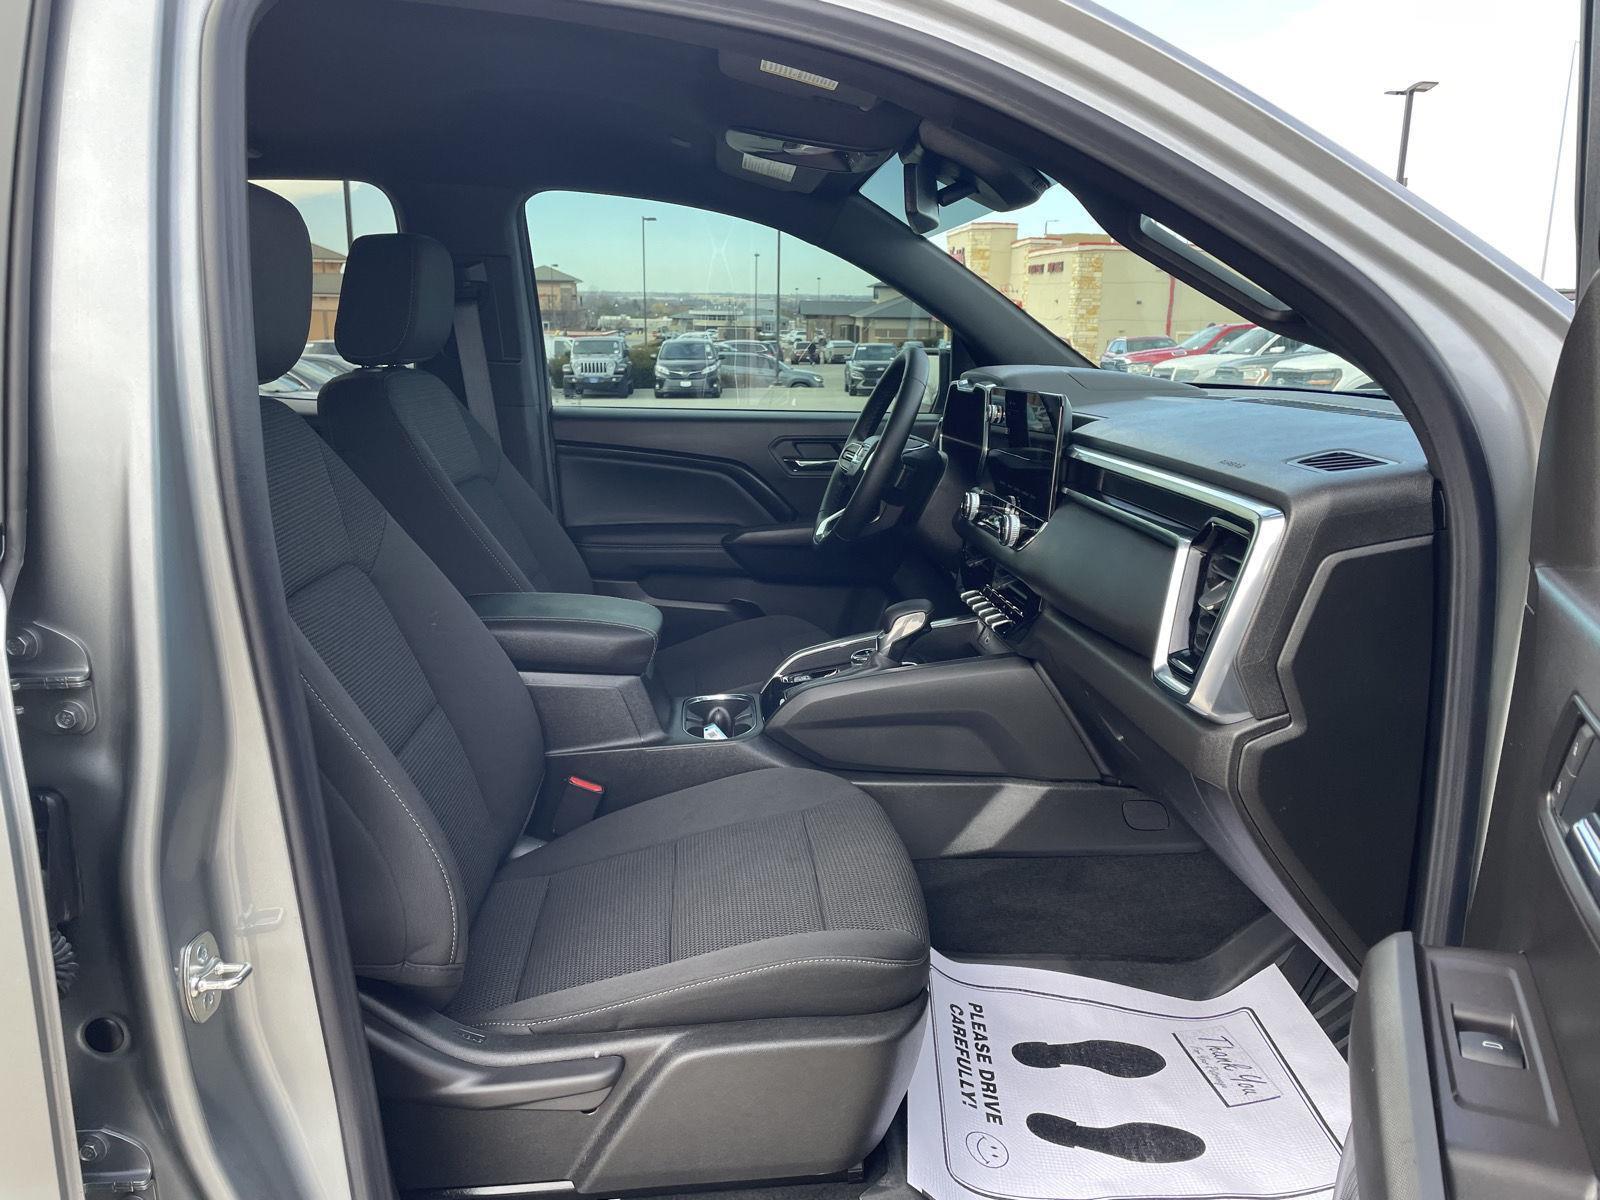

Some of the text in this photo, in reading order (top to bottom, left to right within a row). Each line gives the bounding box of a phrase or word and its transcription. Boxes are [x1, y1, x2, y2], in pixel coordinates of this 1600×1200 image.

[949, 1003, 978, 1110] CAREFULLY!
[968, 1002, 1003, 1126] PLEASE DRIVE
[1197, 1035, 1267, 1095] Thank You
